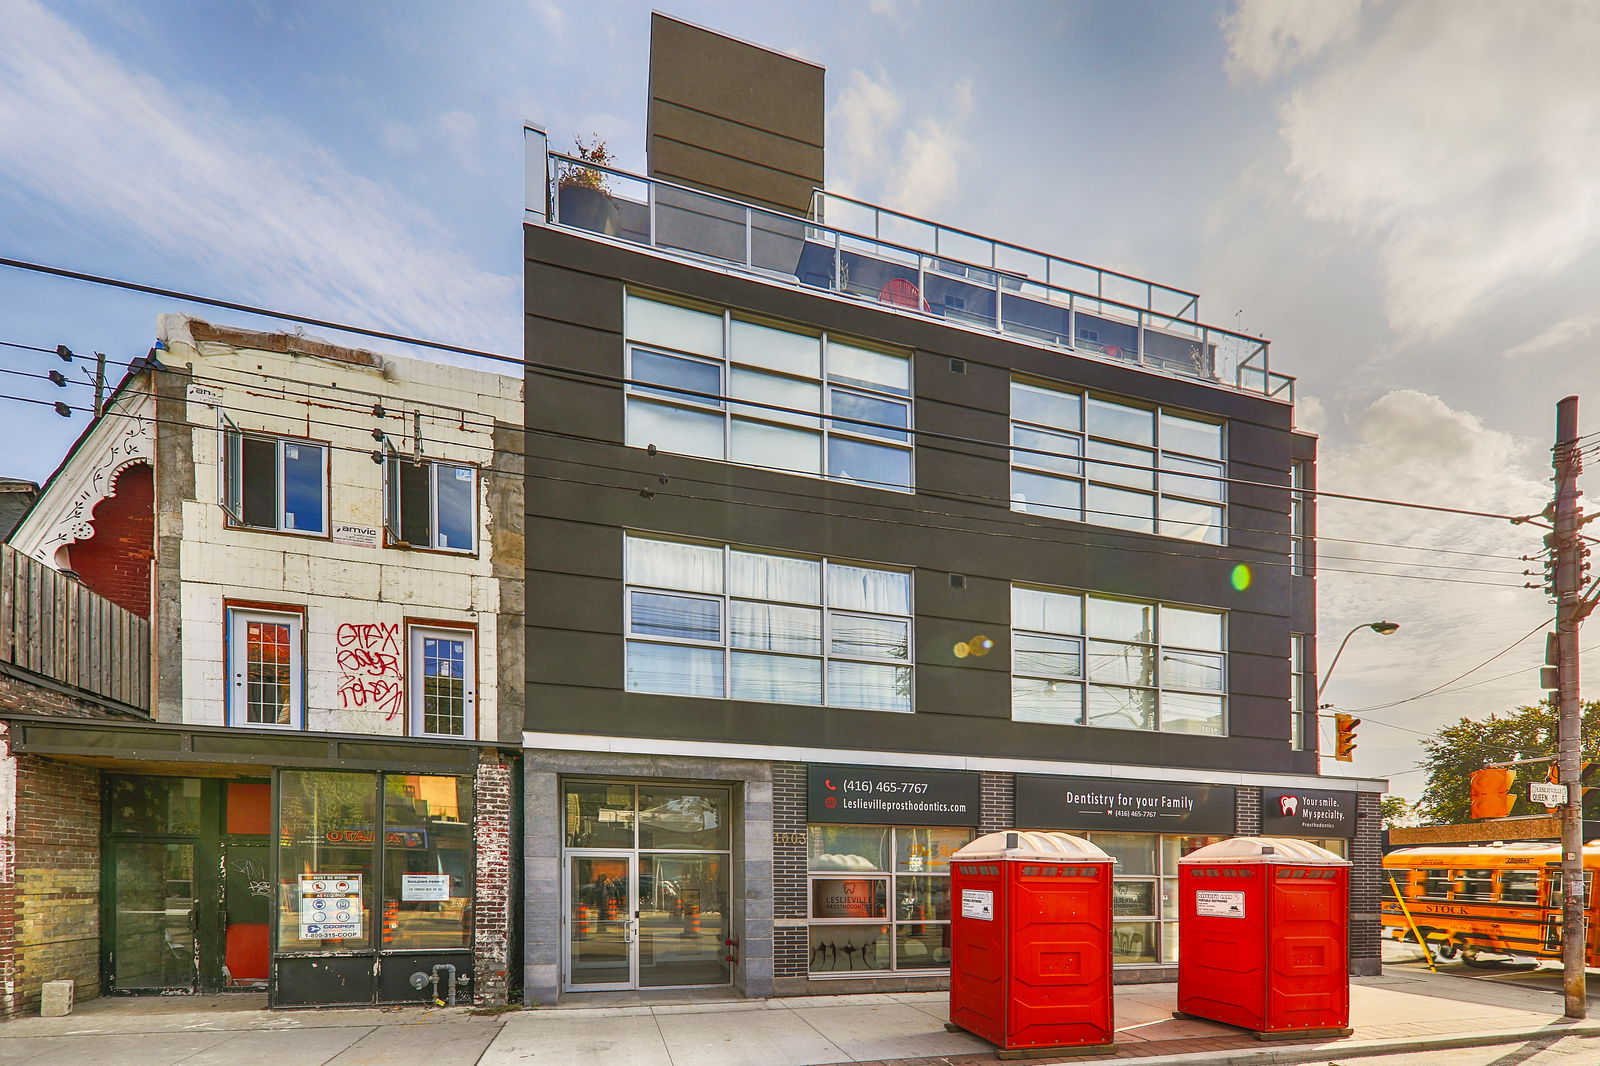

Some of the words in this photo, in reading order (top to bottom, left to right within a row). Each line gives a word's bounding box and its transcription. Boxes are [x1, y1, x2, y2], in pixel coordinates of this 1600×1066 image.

[342, 525, 377, 536] amvic
[842, 779, 873, 793] (416)
[875, 781, 928, 794] 465-7767
[1066, 791, 1114, 808] Dentistry
[1118, 793, 1133, 806] for
[1136, 797, 1158, 809] your
[1161, 796, 1194, 811] Family
[1302, 796, 1318, 806] Your
[1319, 797, 1340, 807] smile.
[1532, 793, 1548, 801] QUEEN
[1551, 794, 1558, 802] ST
[843, 798, 967, 813] Leslievilleprosthodontics.com
[1115, 810, 1130, 818] (416)
[1302, 808, 1313, 820] My
[1313, 809, 1345, 821] specialty.
[774, 832, 806, 844] 1003
[826, 896, 872, 904] LESLIEVILLE
[1425, 904, 1470, 915] STOCK
